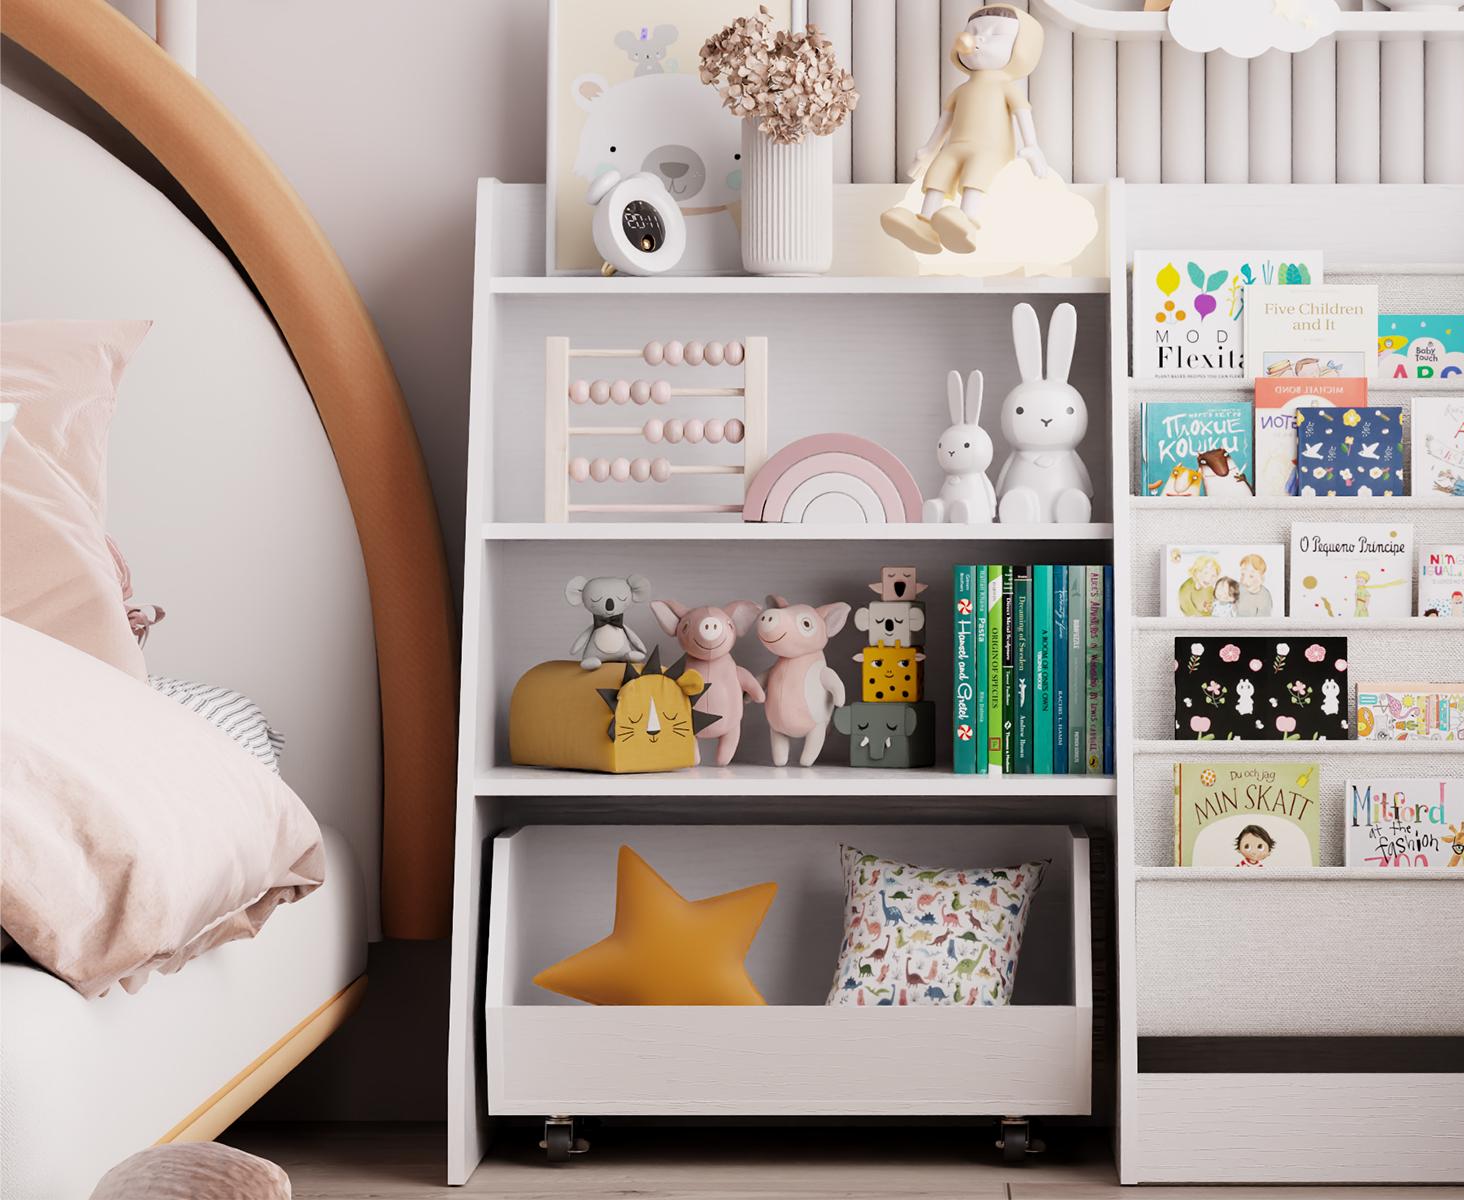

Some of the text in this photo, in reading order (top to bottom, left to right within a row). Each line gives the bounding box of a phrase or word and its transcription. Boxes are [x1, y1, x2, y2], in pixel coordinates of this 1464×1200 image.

[1264, 303, 1364, 315] Five Children
[1292, 318, 1336, 331] and It
[1415, 346, 1436, 356] Baby
[1415, 354, 1438, 362] Touch
[1299, 535, 1310, 553] O
[1312, 535, 1355, 557] Pequeno
[978, 617, 986, 642] Pasta
[1018, 596, 1026, 671] Dreaming of Sweden
[991, 627, 999, 709] ORIGIN OF SPECIES
[1229, 768, 1276, 783] Du och jag
[1194, 784, 1314, 825] MIN SKATT
[1352, 782, 1448, 827] Mitford
[1369, 820, 1411, 839] at the
[1375, 830, 1439, 864] fashion
